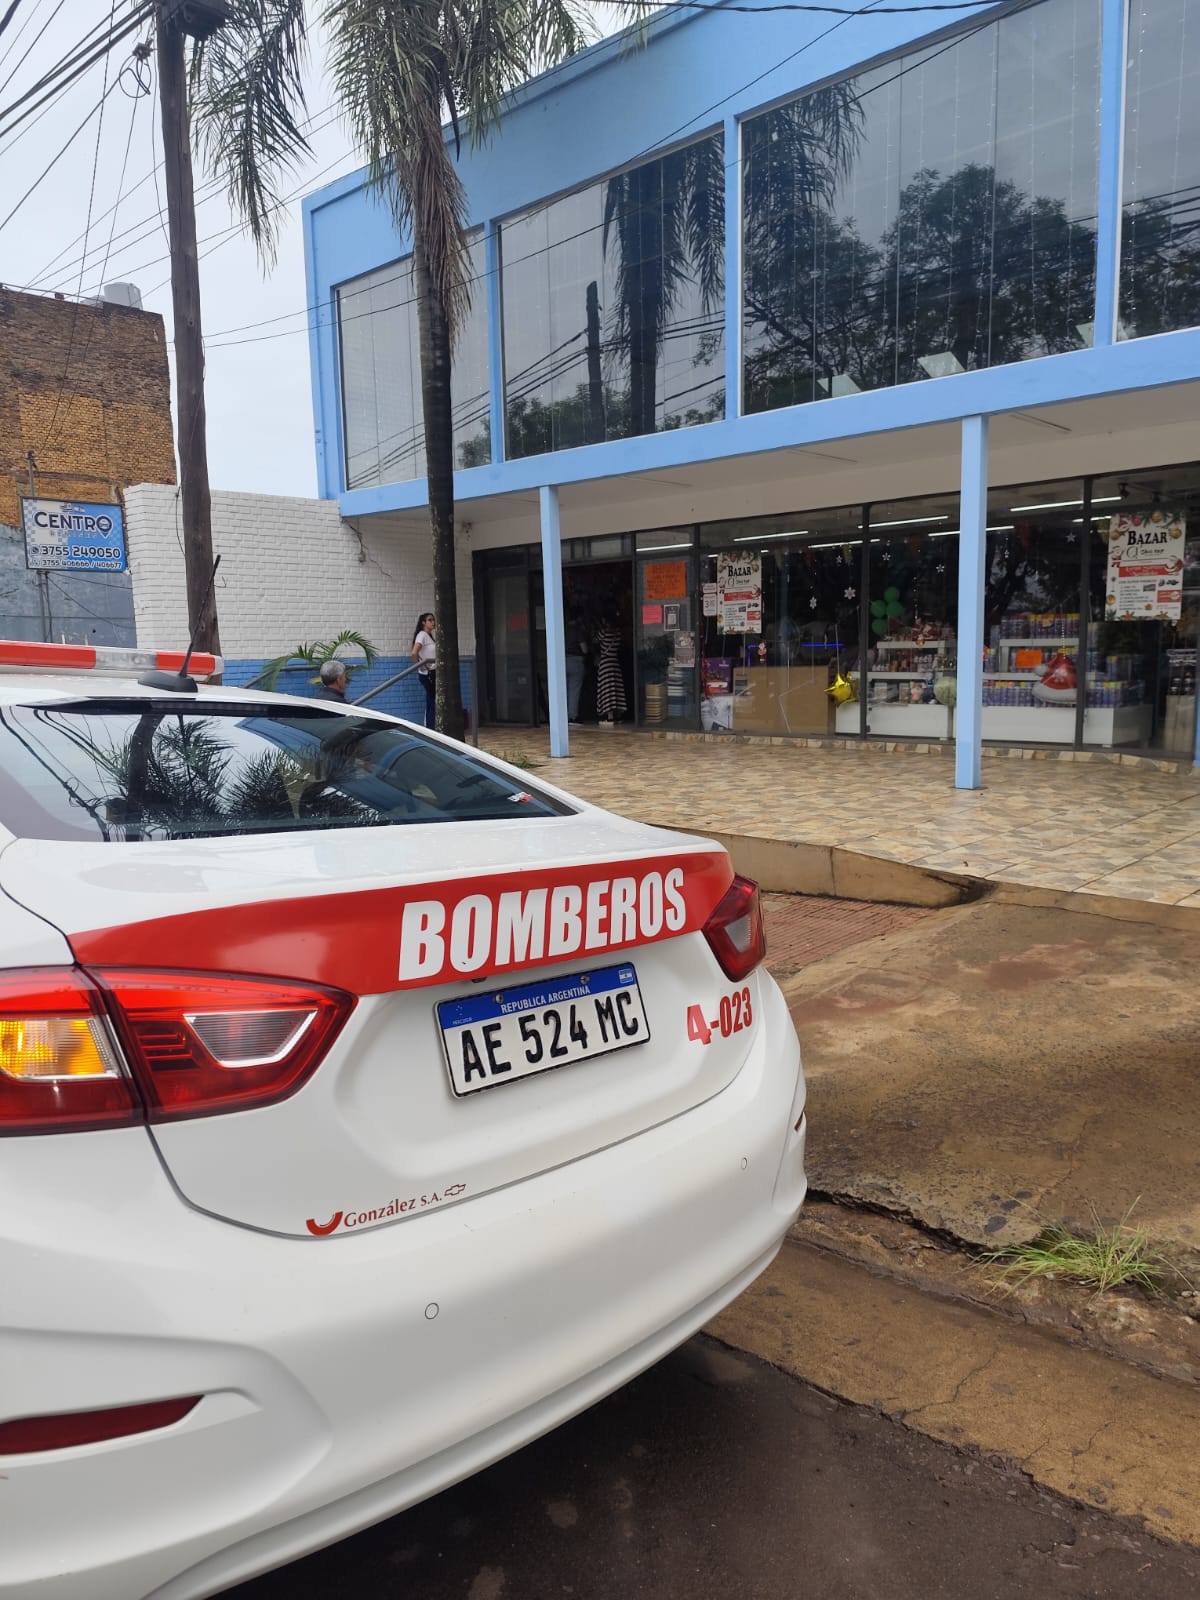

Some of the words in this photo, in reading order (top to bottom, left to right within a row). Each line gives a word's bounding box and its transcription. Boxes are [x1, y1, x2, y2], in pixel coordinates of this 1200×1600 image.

[34, 511, 112, 537] CENTRO
[1127, 530, 1168, 545] BAZAR
[41, 545, 70, 556] 3755
[72, 546, 121, 559] 249050
[42, 559, 60, 567] 3755
[727, 565, 752, 577] BAZAR
[398, 868, 686, 981] BOMBEROS
[500, 995, 547, 1014] REPUBLICA
[548, 985, 591, 1004] ARGENTINA
[686, 987, 753, 1046] 4-023
[461, 1022, 512, 1083] AE
[518, 1004, 588, 1064] 524
[595, 991, 639, 1043] MC
[343, 1198, 416, 1228] González
[420, 1192, 443, 1207] S.A.
